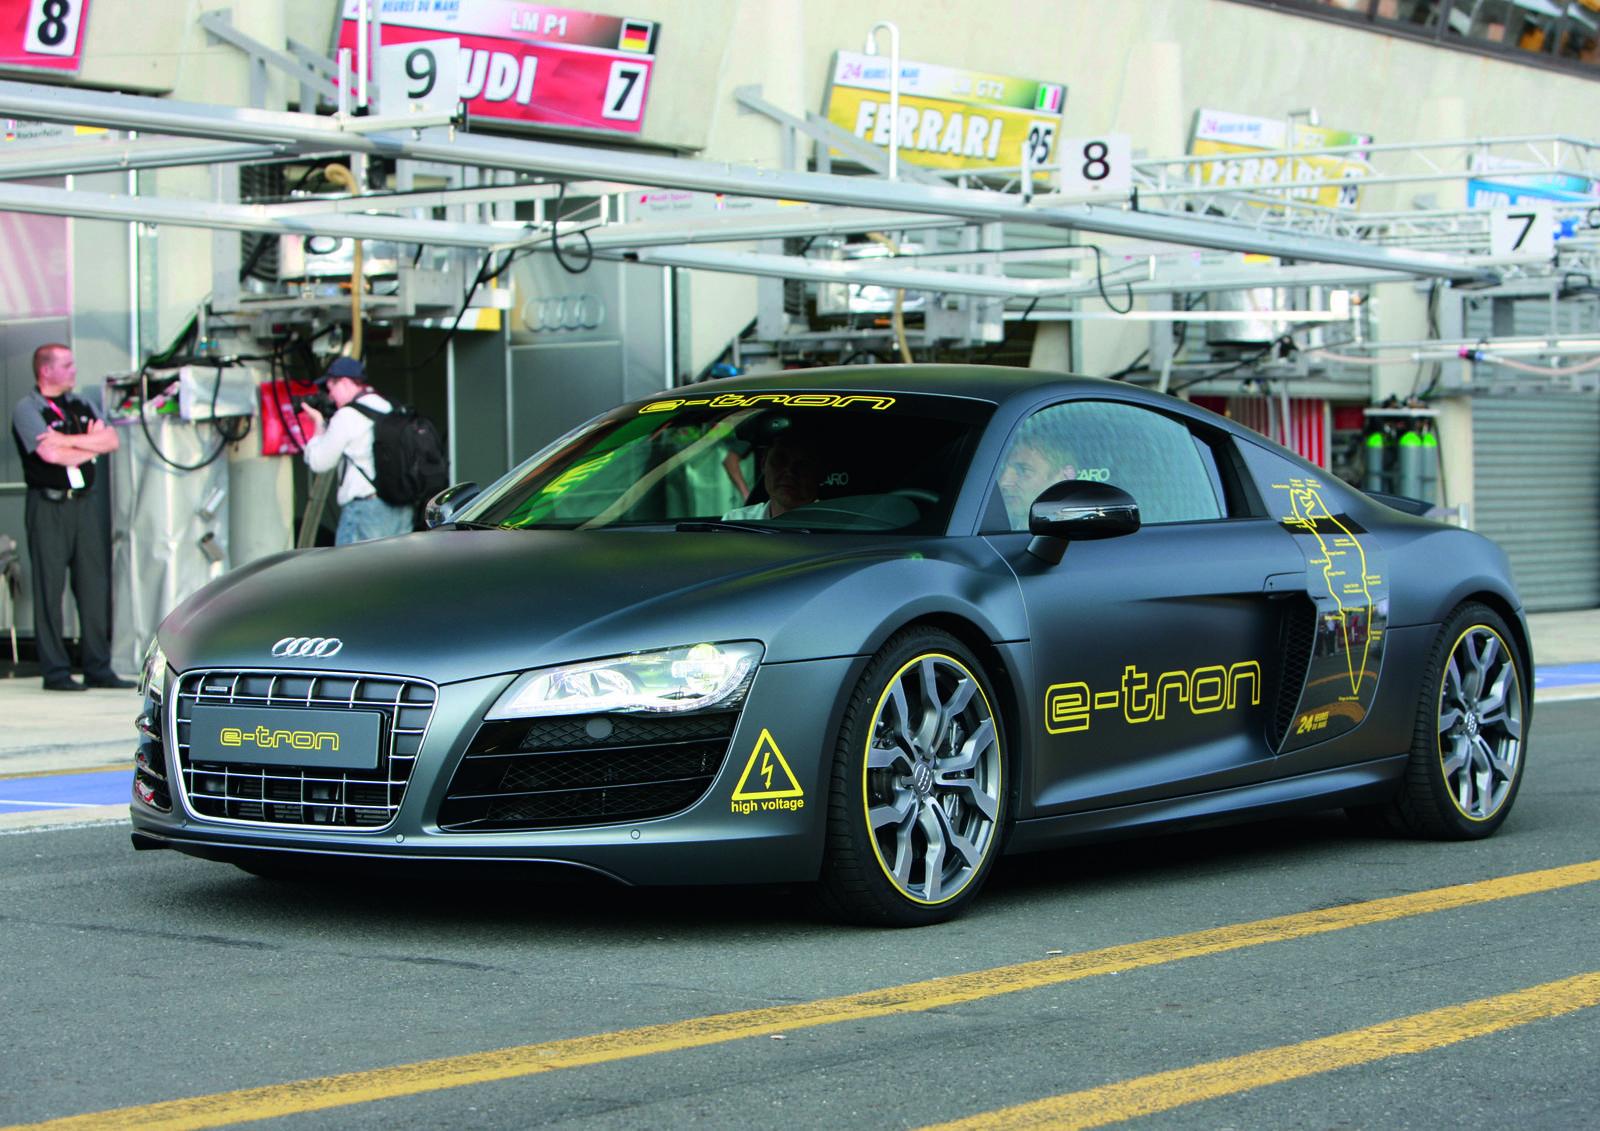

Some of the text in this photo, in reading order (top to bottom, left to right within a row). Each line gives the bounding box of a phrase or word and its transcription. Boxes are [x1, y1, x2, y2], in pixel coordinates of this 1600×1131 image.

[38, 0, 69, 46] 8
[511, 8, 567, 37] LM P1
[405, 47, 437, 99] 9
[459, 48, 538, 105] UDI
[841, 63, 863, 79] 24
[613, 70, 640, 111] 7
[854, 100, 1003, 160] FERRARI
[1028, 127, 1053, 163] 95
[1083, 141, 1110, 180] 8
[1507, 213, 1536, 251] 7
[639, 393, 895, 413] e-tron
[1045, 660, 1260, 734] e-tron
[220, 725, 339, 751] e-tron
[731, 798, 804, 814] high voltage
